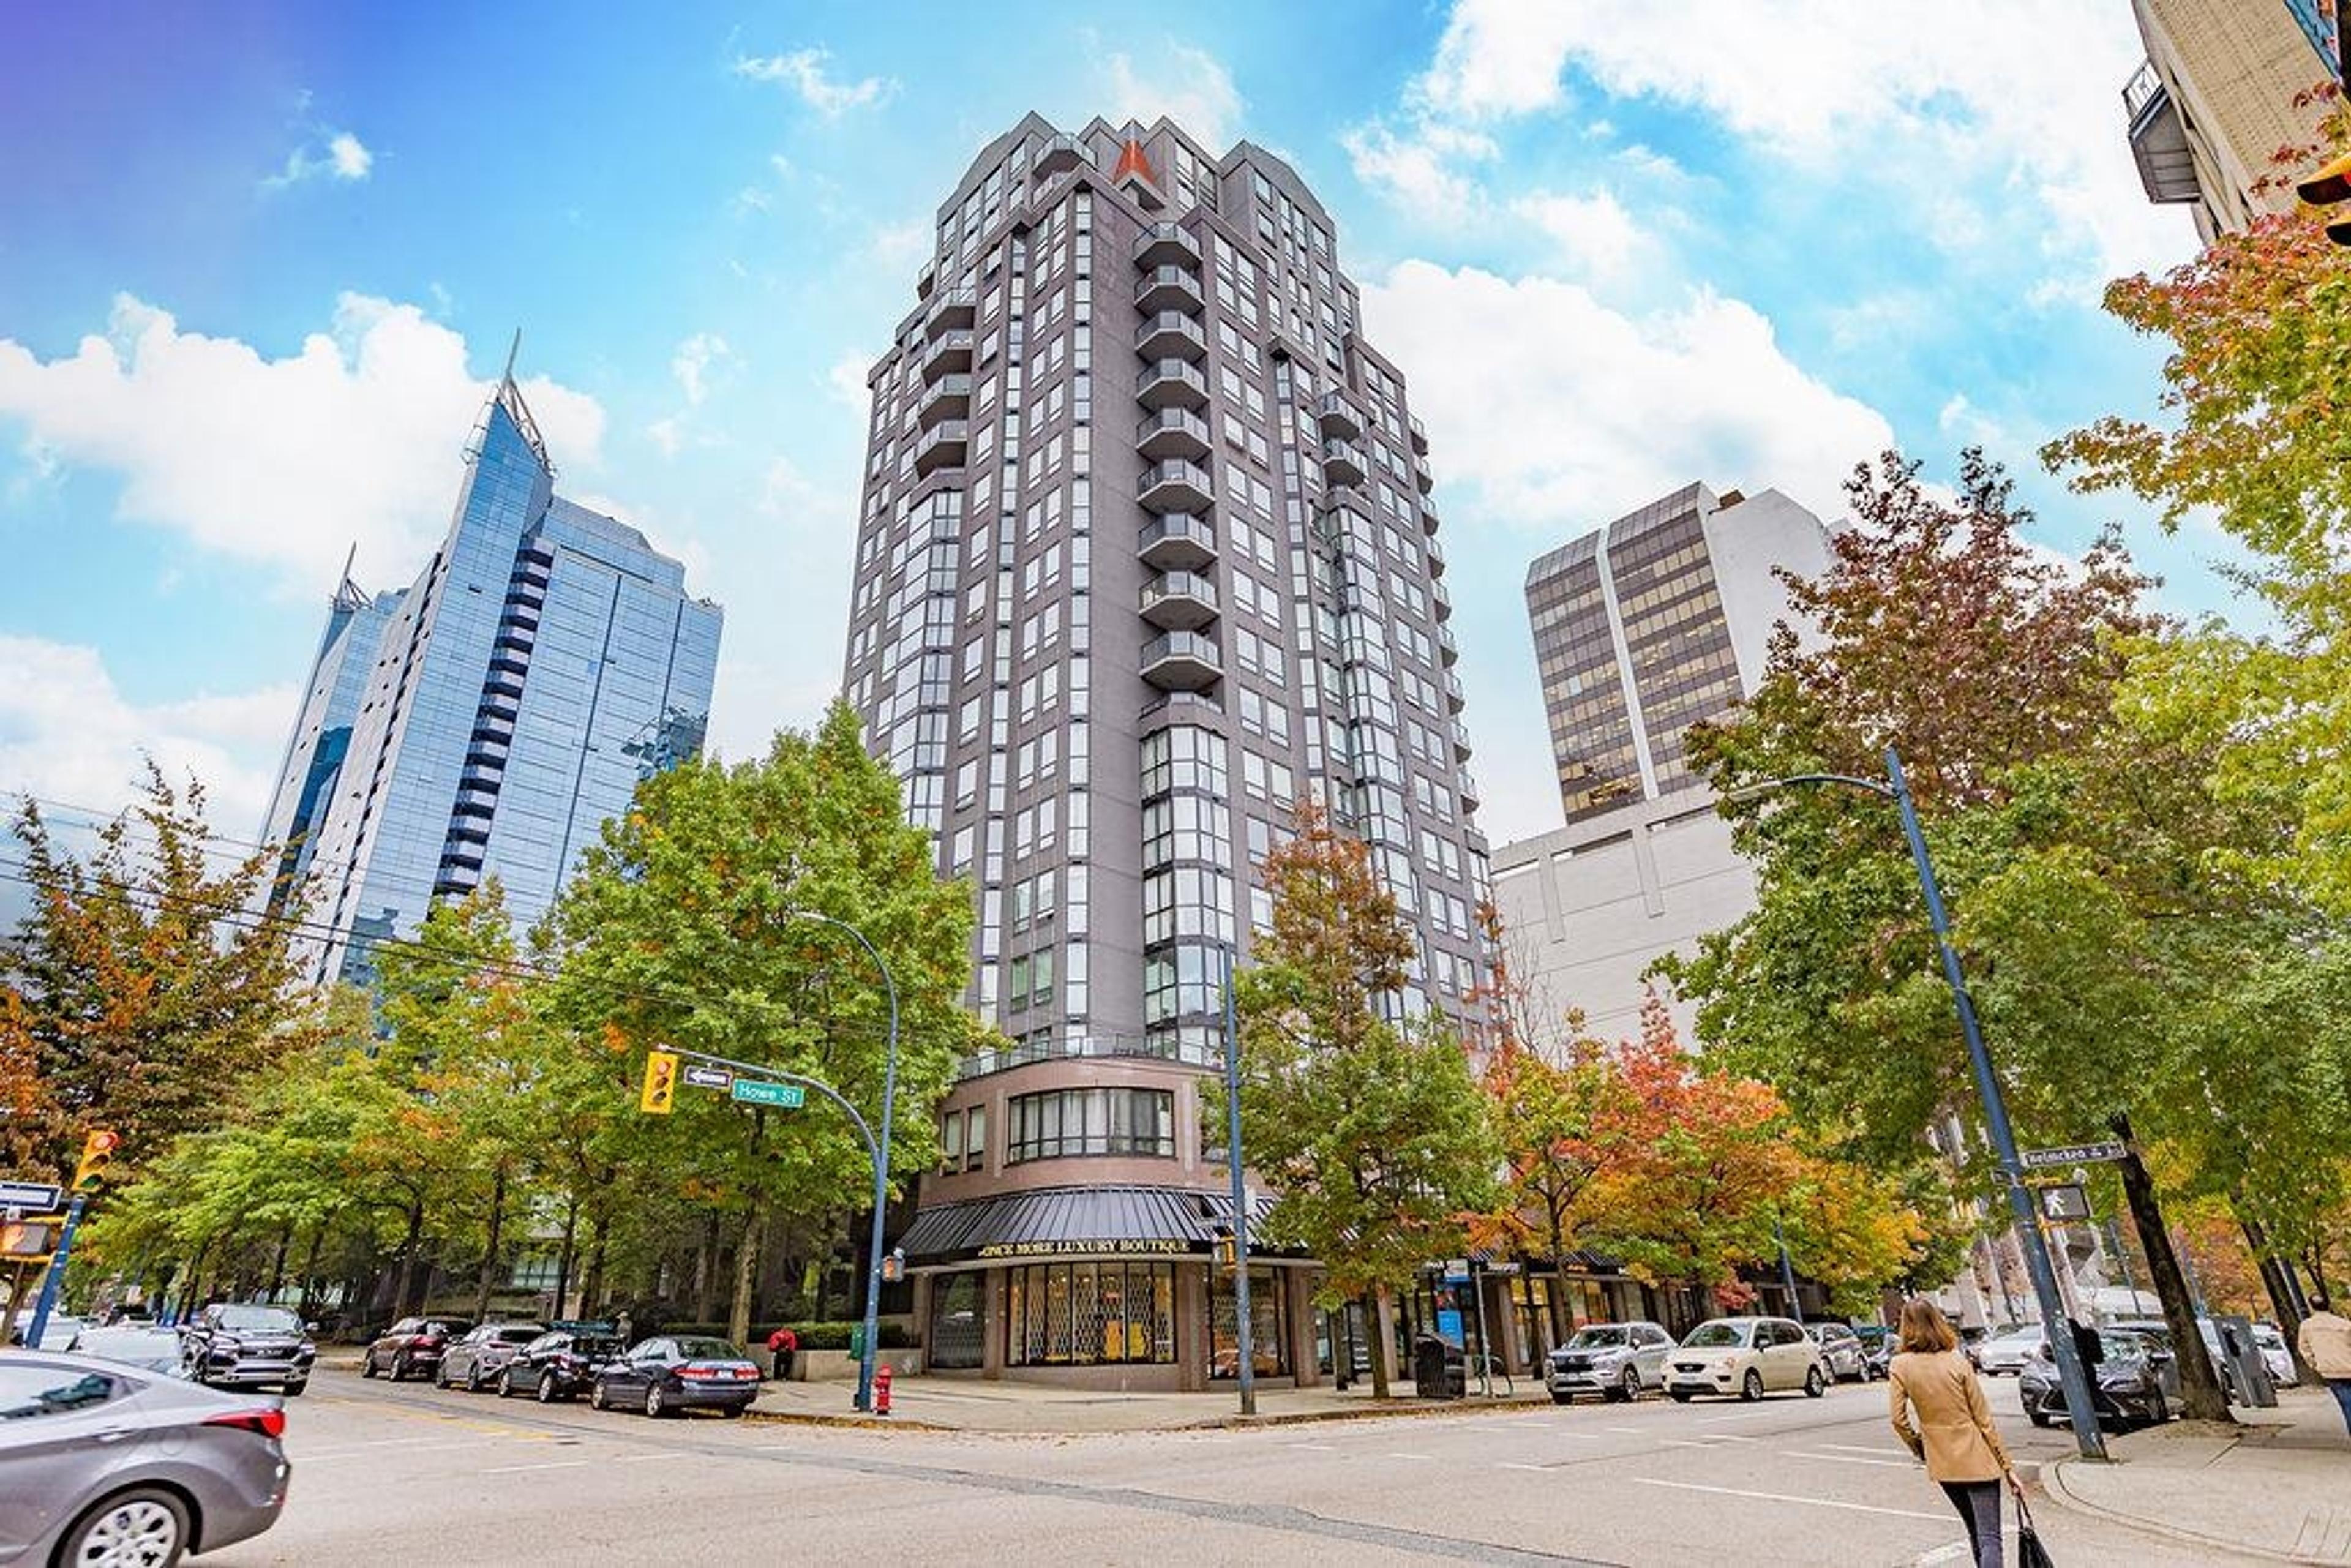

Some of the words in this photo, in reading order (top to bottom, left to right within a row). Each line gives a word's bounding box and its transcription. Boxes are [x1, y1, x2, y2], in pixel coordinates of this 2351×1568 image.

[738, 1083, 777, 1101] Howe
[782, 1090, 796, 1103] St
[1016, 1242, 1055, 1255] MORE
[1057, 1240, 1117, 1253] LUXURY
[1120, 1238, 1191, 1255] BOUTIQUE
